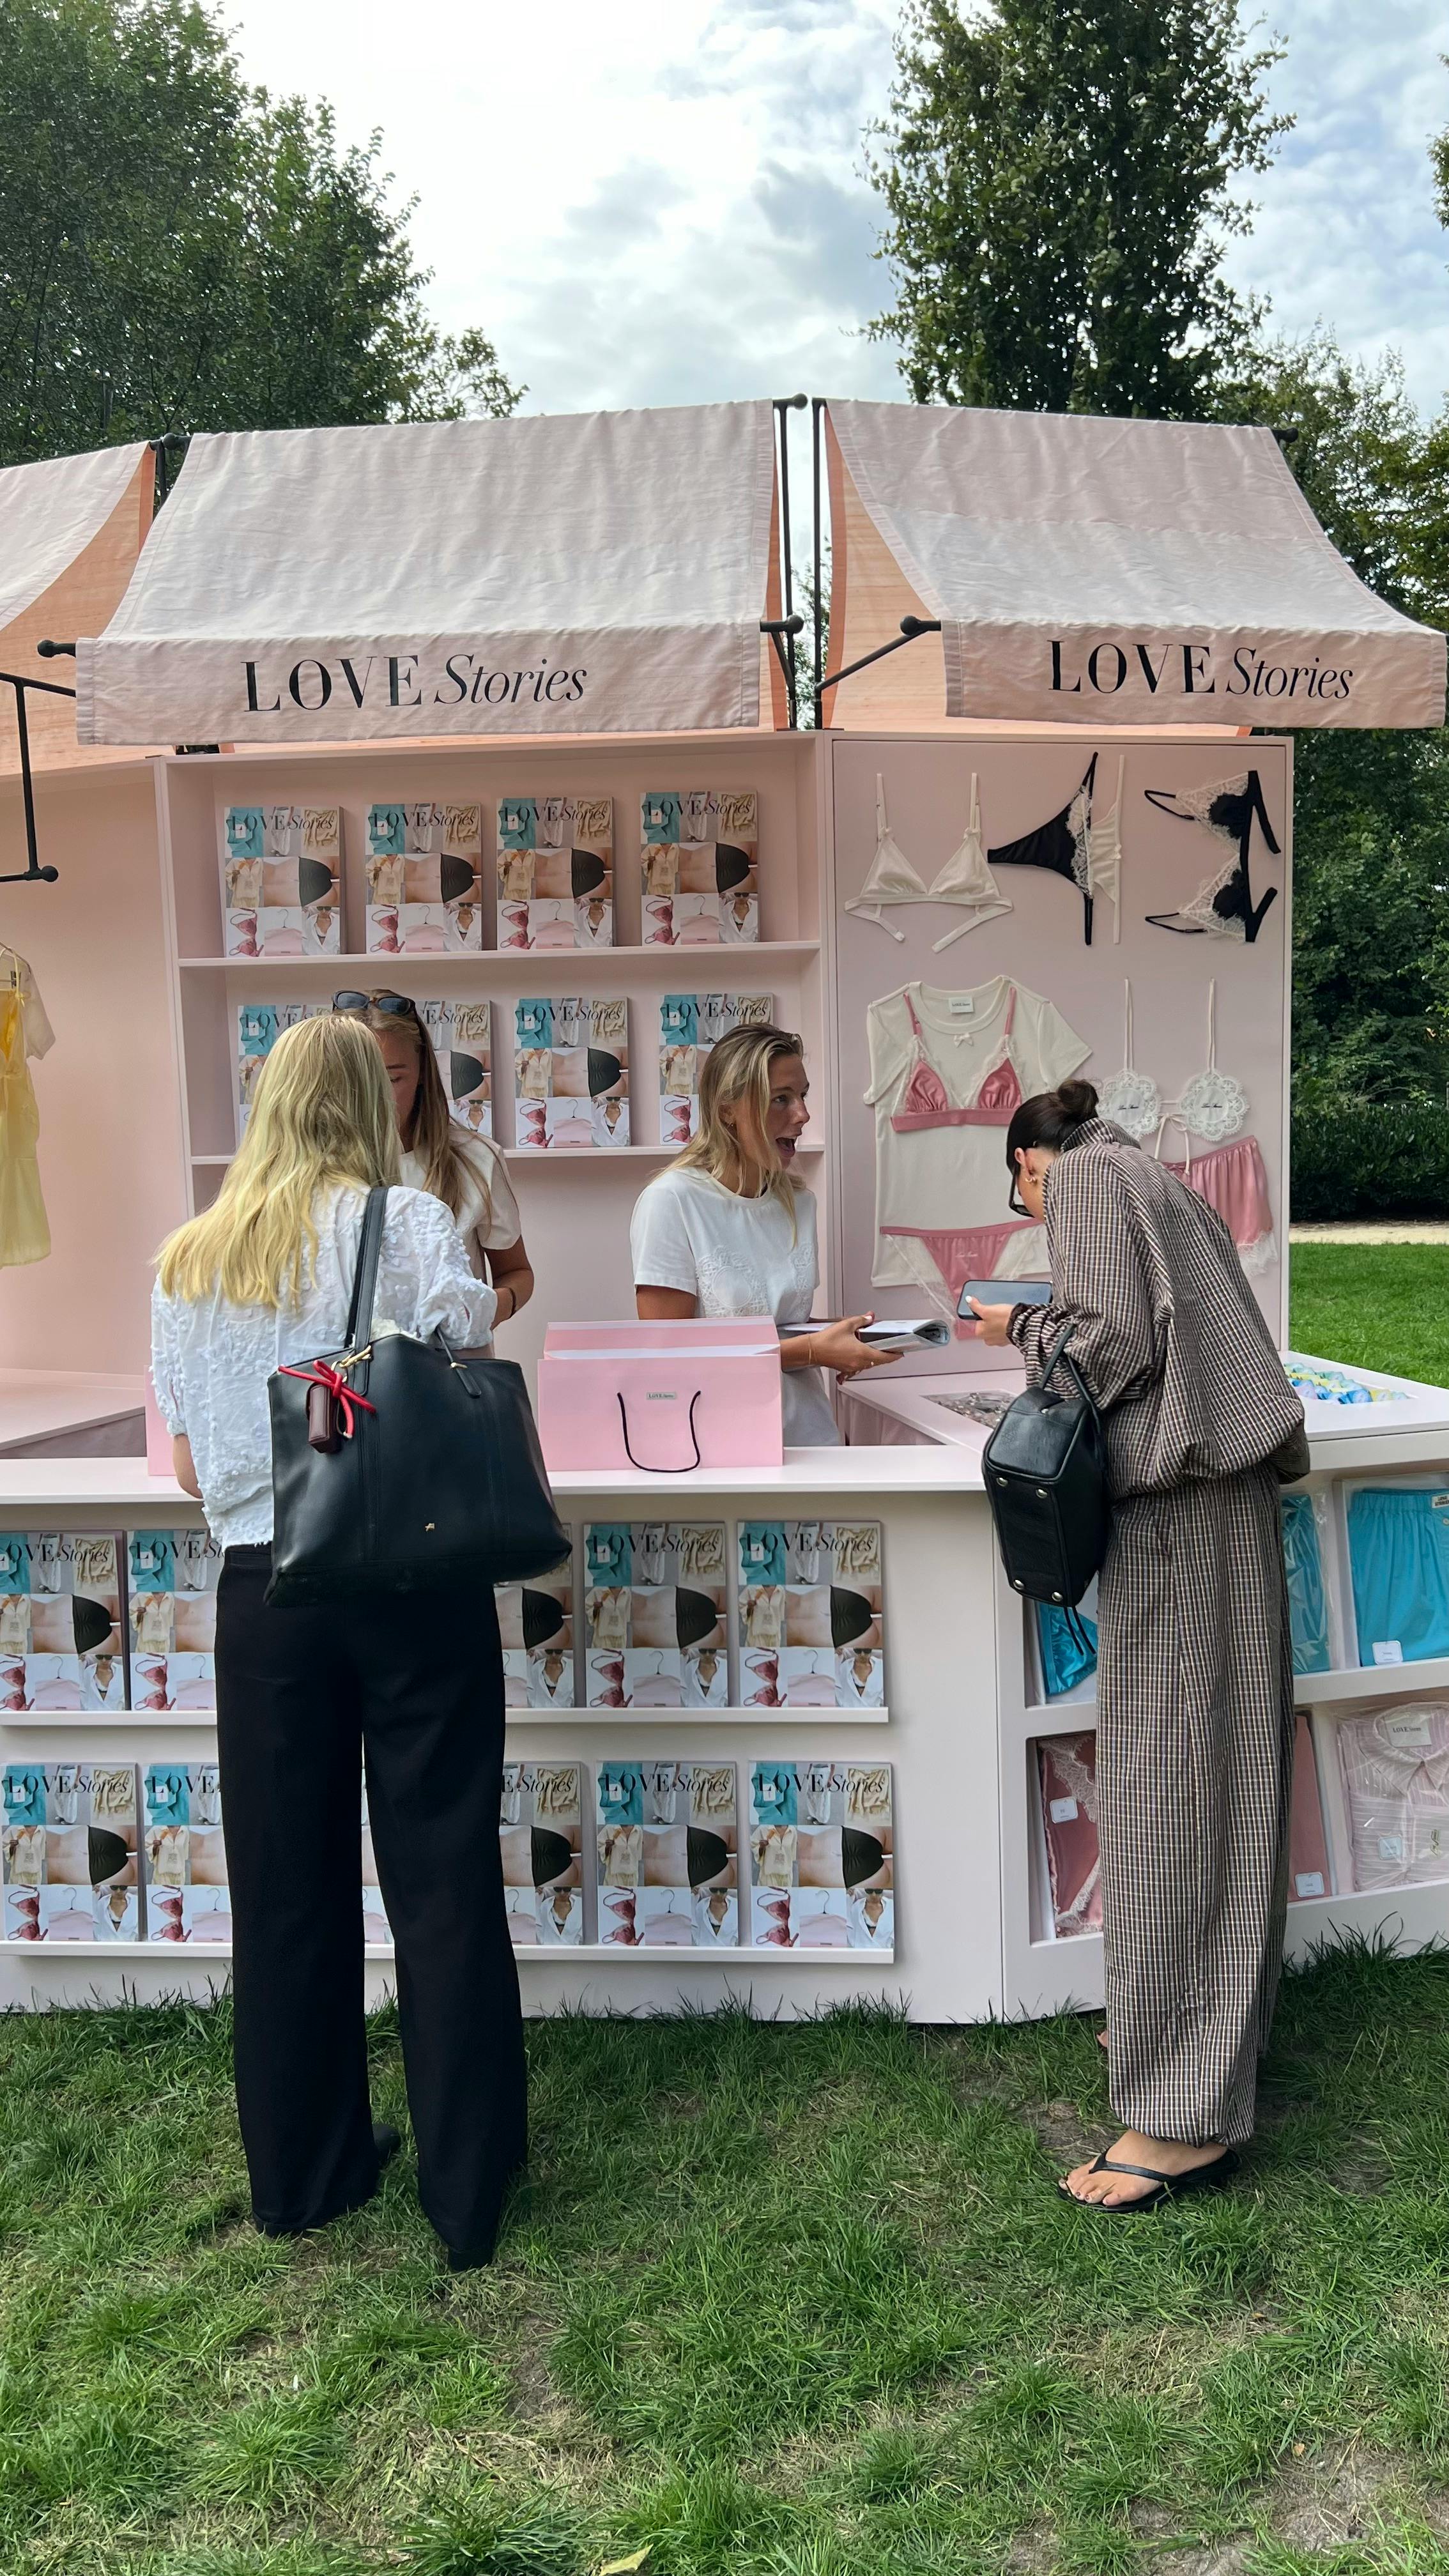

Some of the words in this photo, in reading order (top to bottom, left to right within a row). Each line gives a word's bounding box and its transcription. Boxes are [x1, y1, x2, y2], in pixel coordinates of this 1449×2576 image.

[1046, 640, 1215, 694] LOVE
[1225, 647, 1353, 699] Stories
[240, 654, 422, 712] LOVE
[434, 653, 588, 704] Stories
[504, 806, 558, 822] LOVE
[562, 806, 606, 822] Stories
[647, 800, 702, 816] LOVE
[705, 800, 750, 816] Stories
[231, 815, 286, 831] LOVE
[288, 812, 333, 830] Stories
[374, 812, 427, 827] LOVE
[430, 809, 475, 827] Stories
[440, 1009, 484, 1024] Stories
[521, 1006, 574, 1022] LOVE
[576, 1005, 622, 1021] Stories
[665, 1002, 719, 1018] LOVE
[721, 1002, 767, 1017] Stories
[136, 1540, 201, 1559] LOVE
[593, 1535, 659, 1553] LOVE
[663, 1535, 719, 1552] Stories
[746, 1533, 812, 1551] LOVE
[817, 1533, 873, 1551] Stories
[58, 1544, 109, 1562] Stories
[8, 1775, 70, 1793] LOVE
[75, 1775, 128, 1793] Stories
[152, 1775, 214, 1793] LOVE
[518, 1774, 572, 1793] Stories
[605, 1774, 670, 1792] LOVE
[674, 1774, 728, 1792] Stories
[758, 1774, 824, 1792] LOVE
[829, 1774, 884, 1792] Stories
